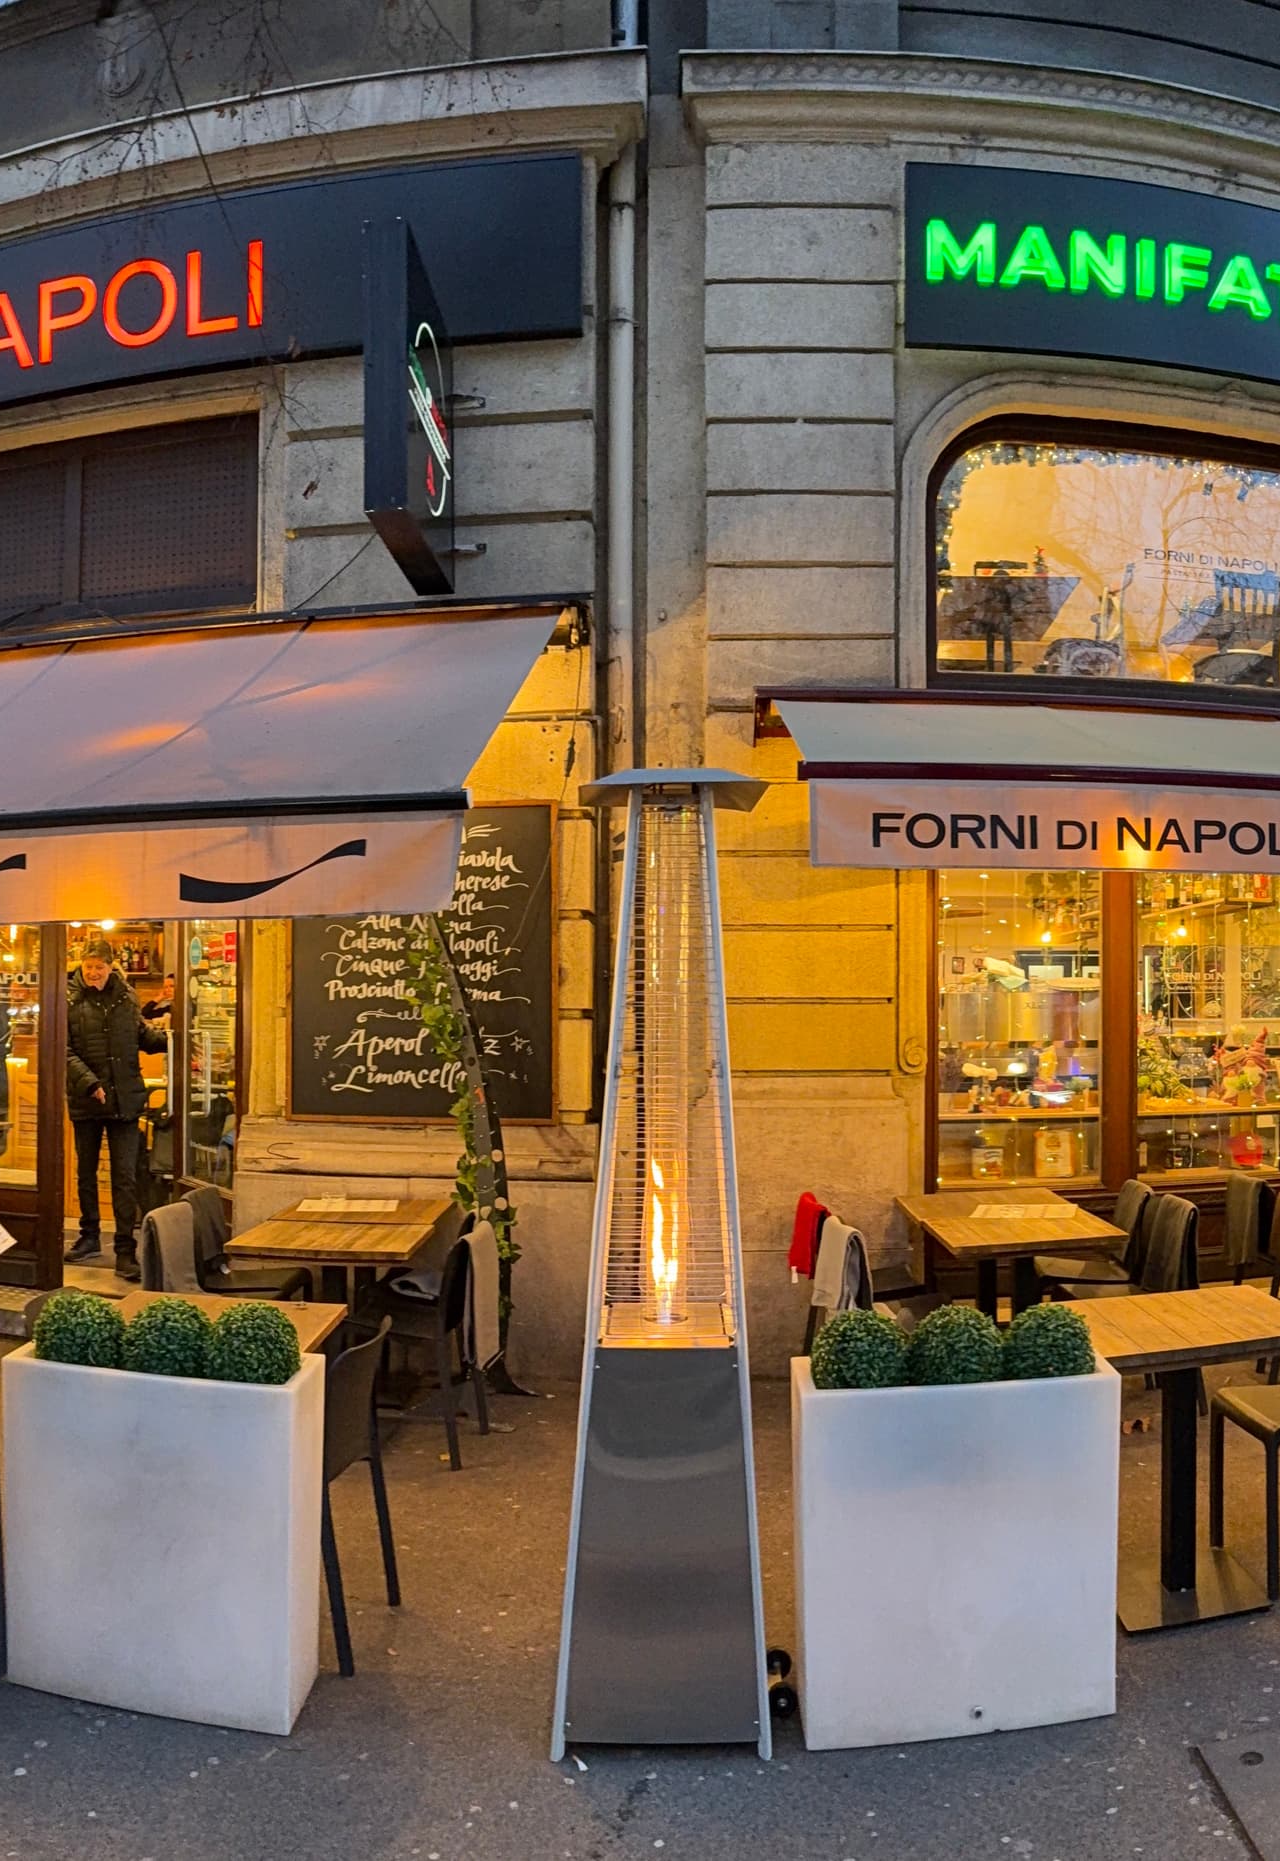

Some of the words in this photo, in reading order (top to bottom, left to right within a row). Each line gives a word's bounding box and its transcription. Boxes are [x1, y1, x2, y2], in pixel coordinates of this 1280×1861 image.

[1144, 548, 1194, 564] FORNI
[1199, 554, 1213, 565] DI
[1217, 556, 1279, 573] NAPOLI
[872, 813, 1038, 850] FORNI
[1057, 820, 1097, 850] DI
[458, 847, 523, 873] iavola
[325, 980, 417, 1000] Prosciutto
[333, 1029, 430, 1067] Aperol
